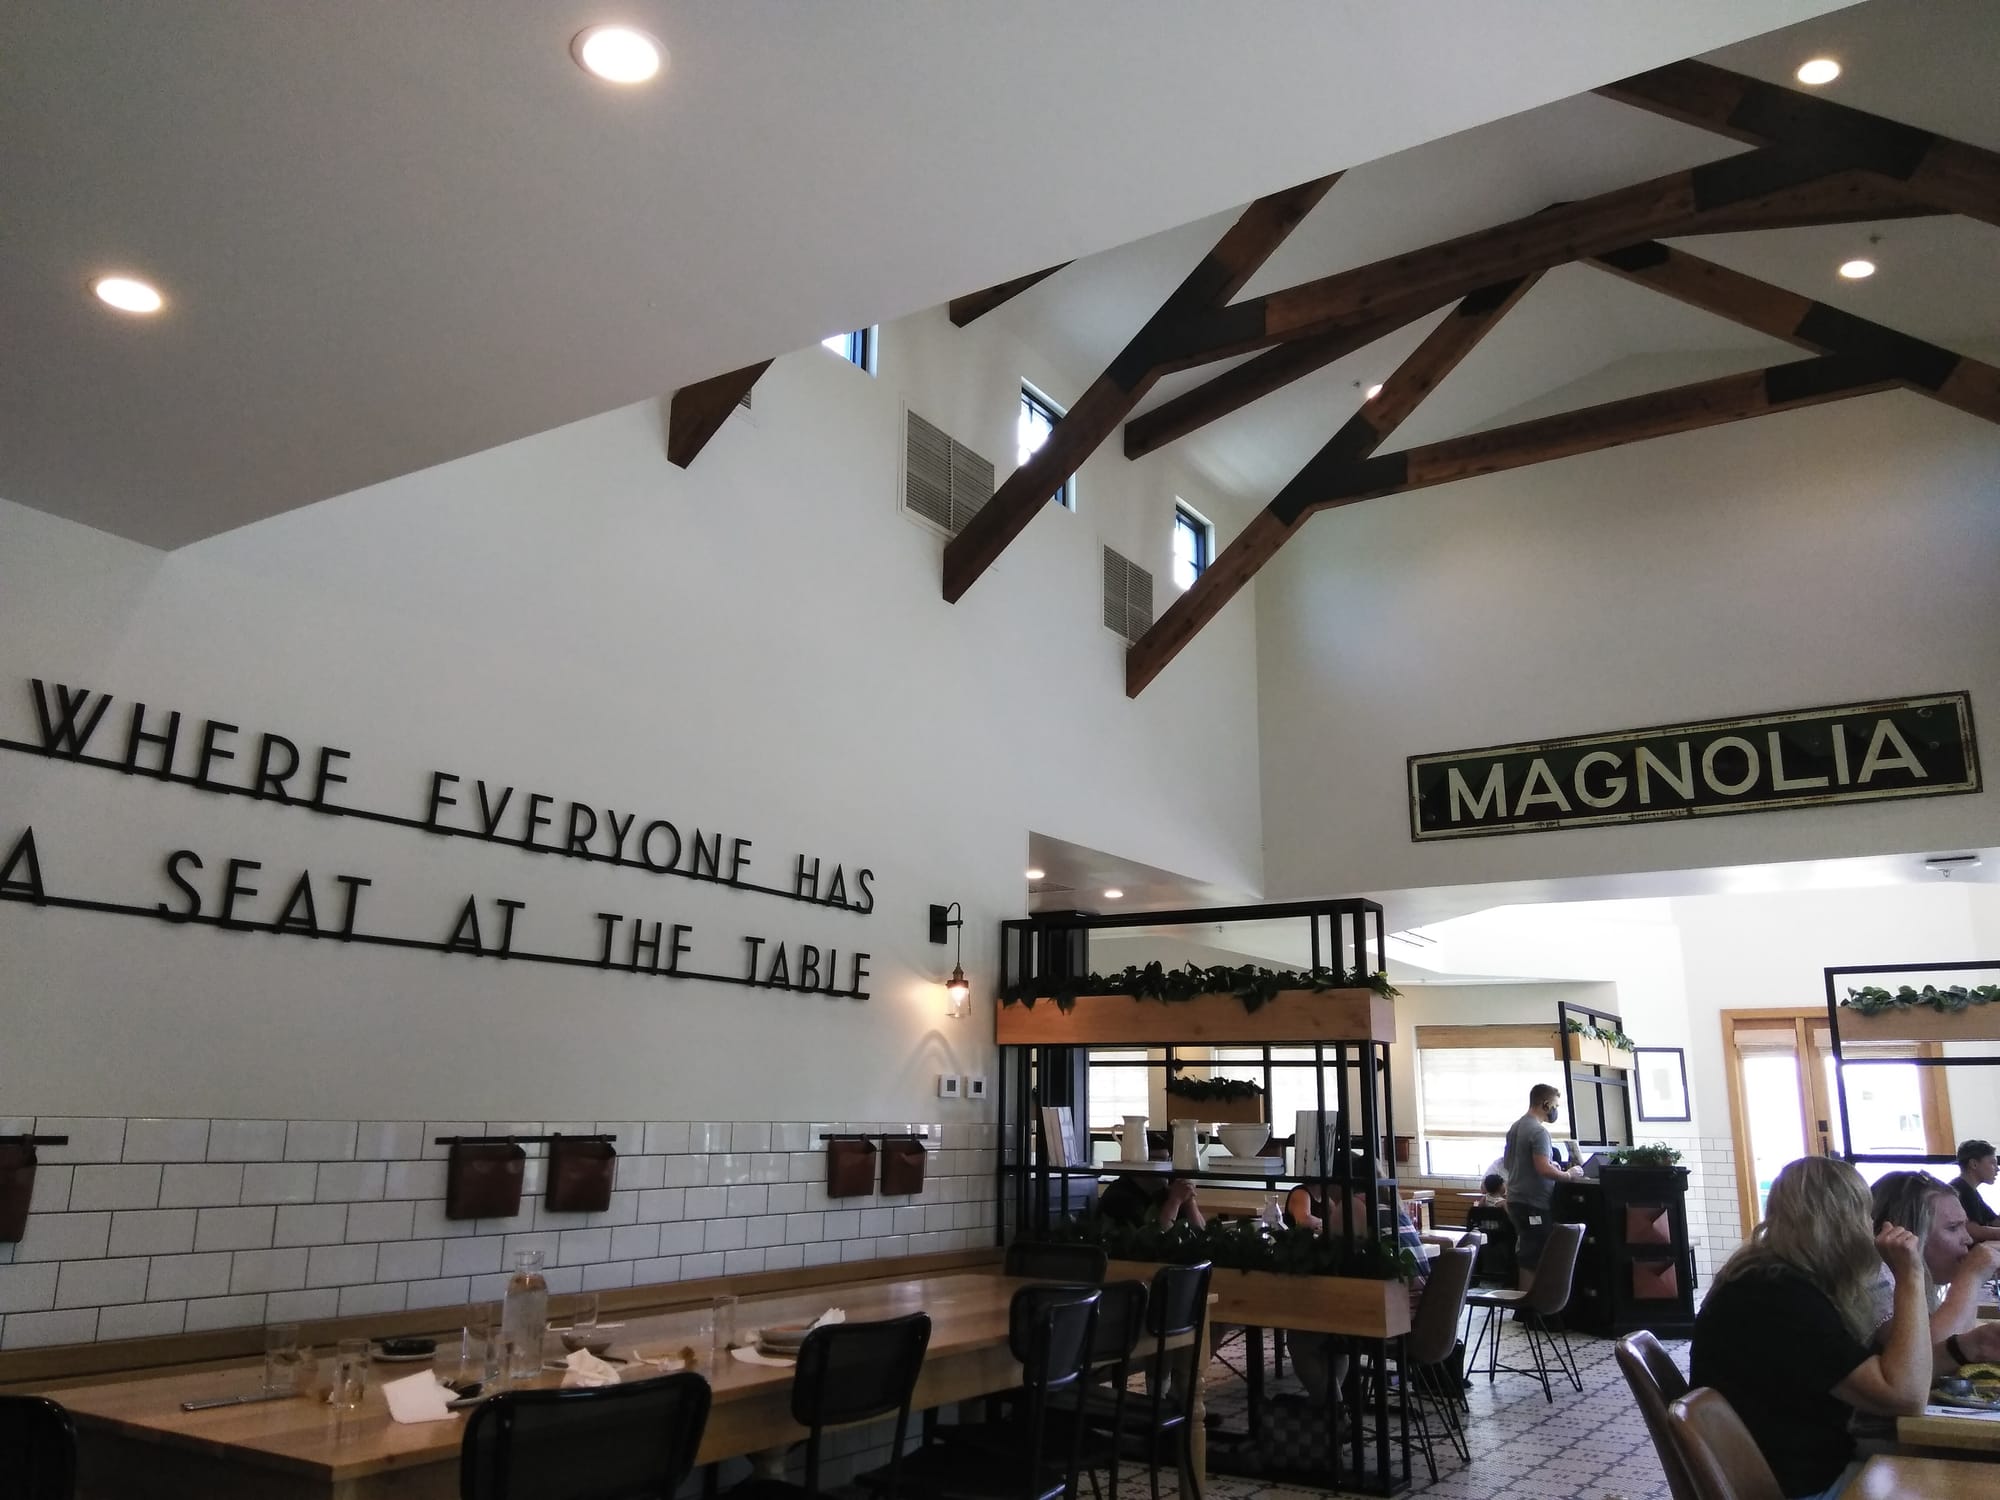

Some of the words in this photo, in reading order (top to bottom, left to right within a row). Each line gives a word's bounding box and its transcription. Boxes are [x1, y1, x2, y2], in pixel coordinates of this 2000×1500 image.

[31, 678, 351, 816] WHERE
[424, 771, 752, 889] EVERYONE
[796, 854, 874, 914] HAS
[1448, 718, 1928, 822] MAGNOLIA
[0, 825, 47, 907] A
[158, 850, 372, 942] SEAT
[444, 893, 526, 960] AT
[598, 913, 693, 978] THE
[745, 936, 871, 1000] TABLE
